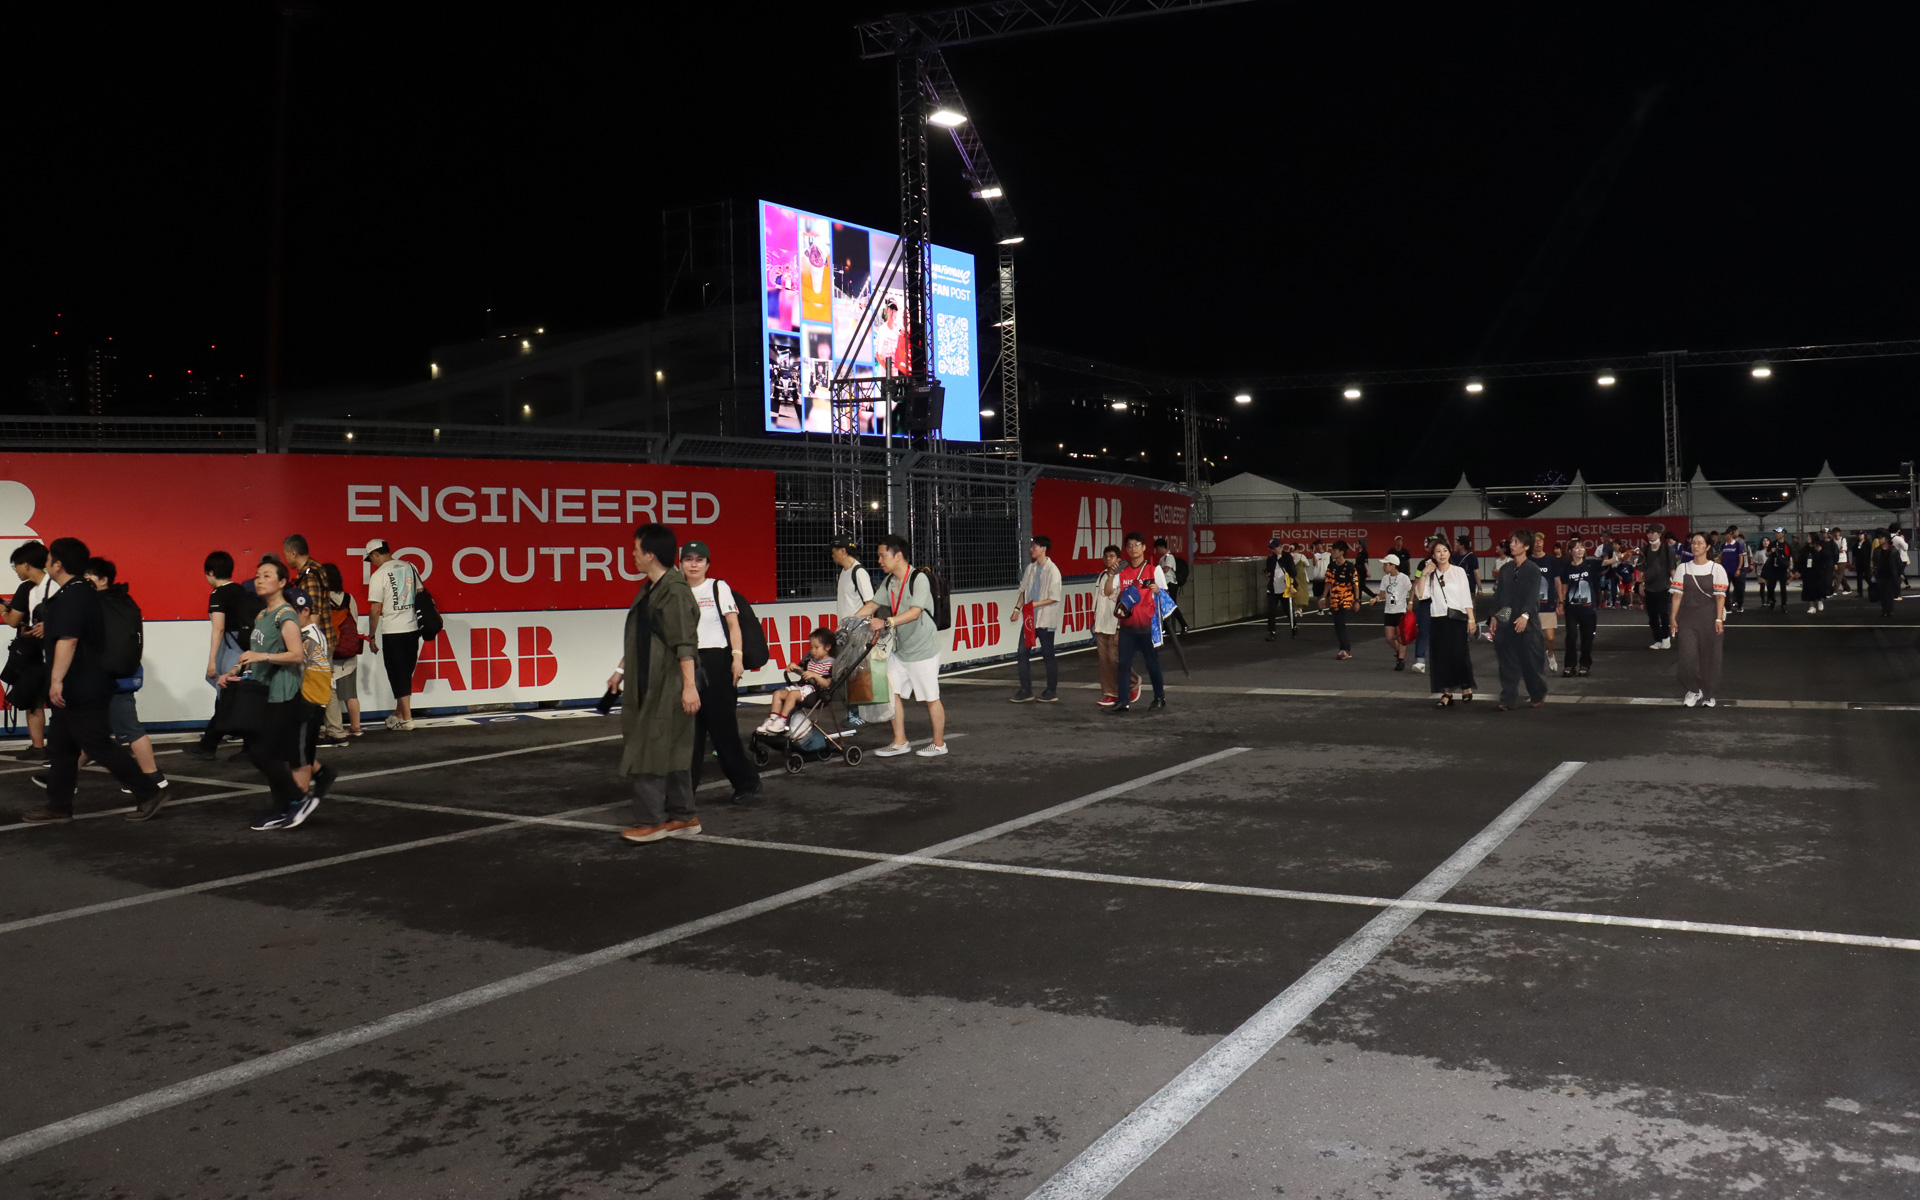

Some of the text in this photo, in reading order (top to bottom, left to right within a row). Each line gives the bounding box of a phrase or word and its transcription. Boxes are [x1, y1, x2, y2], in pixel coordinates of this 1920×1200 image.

[931, 282, 971, 301] FAN POST
[347, 484, 721, 525] ENGINEERED
[1271, 529, 1368, 539] ENGINEERED
[452, 546, 683, 584] OUTRU
[1568, 571, 1590, 580] TOKYO
[387, 572, 399, 607] JAKARTA
[951, 602, 1001, 651] ABB
[1061, 592, 1095, 634] ABB
[410, 626, 558, 693] ABB
